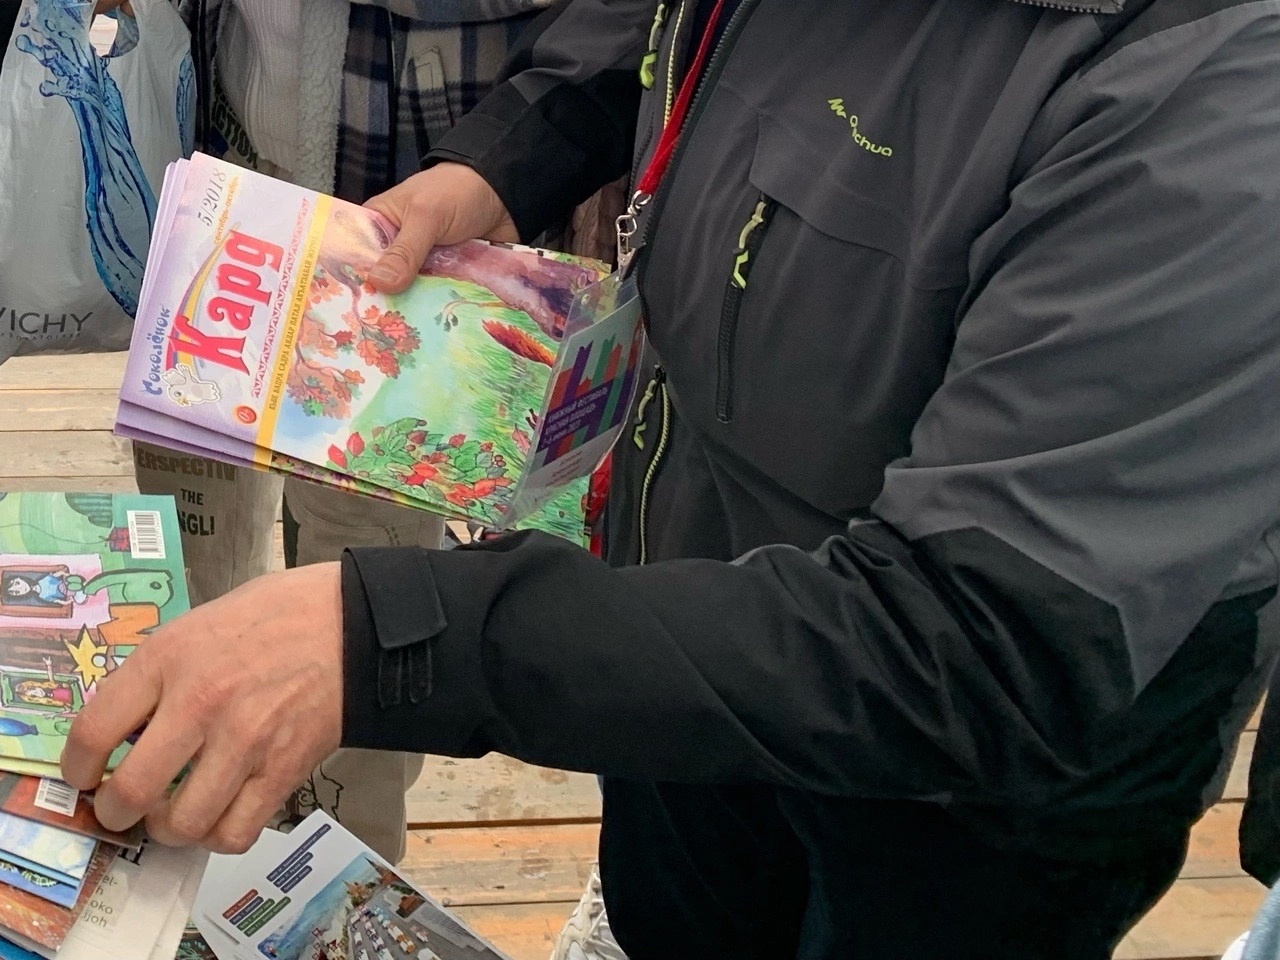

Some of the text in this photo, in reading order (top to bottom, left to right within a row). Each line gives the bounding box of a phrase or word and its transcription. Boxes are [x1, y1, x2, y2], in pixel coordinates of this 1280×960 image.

[197, 168, 228, 227] 5/2018
[214, 175, 240, 245] сентябрь-октябрь
[168, 229, 285, 376] Кард
[141, 305, 171, 396] Соколёнок
[180, 488, 204, 506] THE
